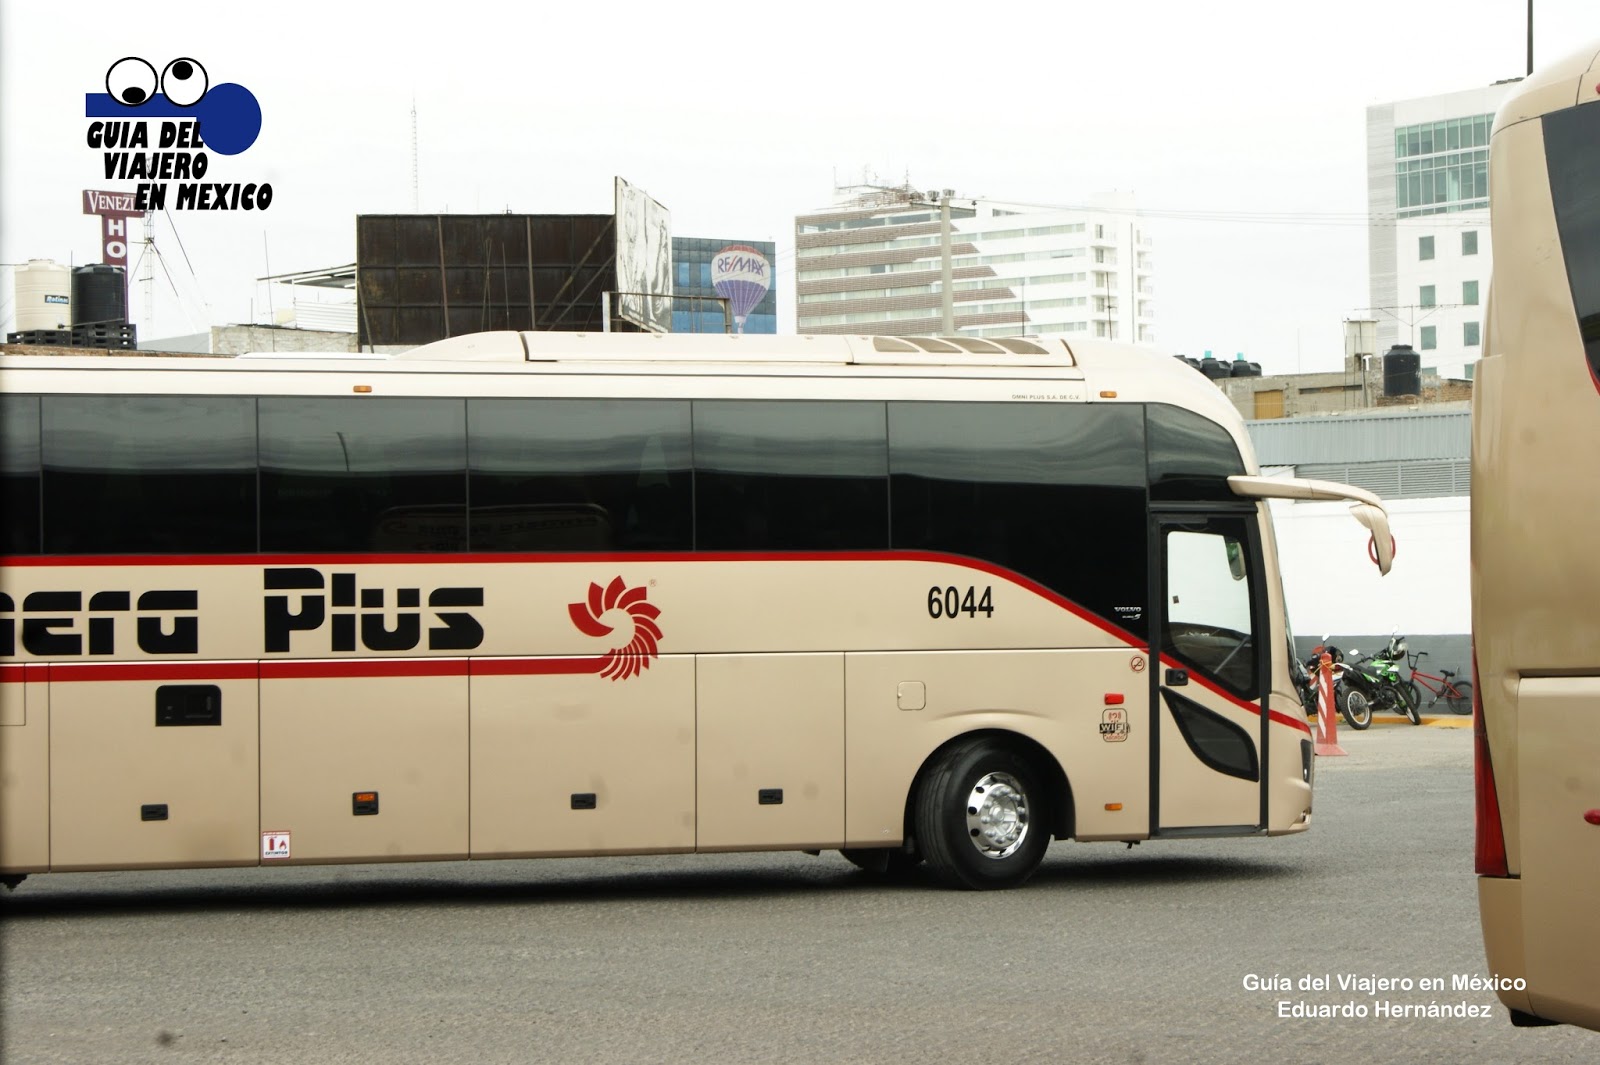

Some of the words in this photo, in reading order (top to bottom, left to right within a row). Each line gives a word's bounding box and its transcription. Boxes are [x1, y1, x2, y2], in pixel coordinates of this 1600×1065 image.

[87, 190, 145, 213] VENEZI
[264, 567, 485, 653] Plus
[927, 585, 994, 619] 6044
